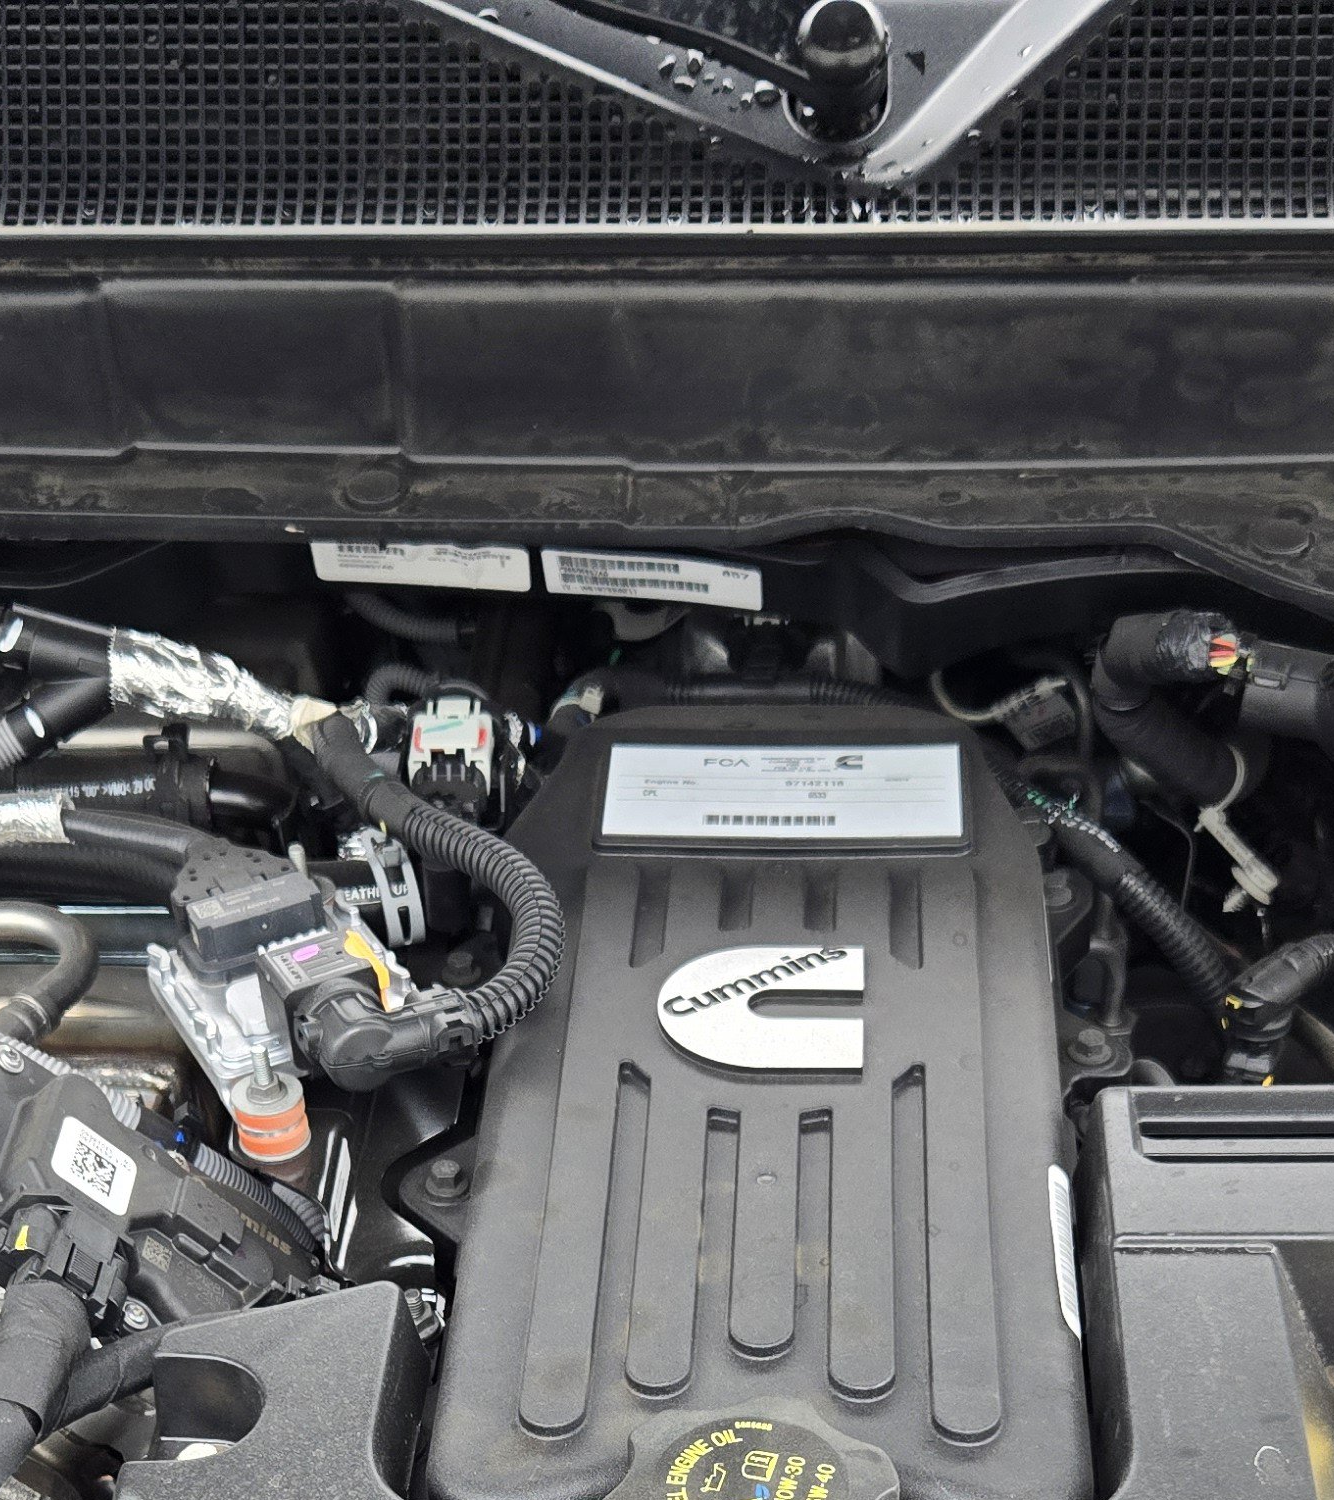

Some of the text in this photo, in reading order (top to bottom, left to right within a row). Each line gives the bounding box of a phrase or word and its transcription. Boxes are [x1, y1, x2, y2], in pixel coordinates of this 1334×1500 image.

[704, 757, 750, 768] FCA
[644, 778, 679, 787] Engine
[663, 947, 848, 1018] Cummins
[666, 1438, 714, 1485] ENGINE
[710, 1429, 743, 1447] OIL
